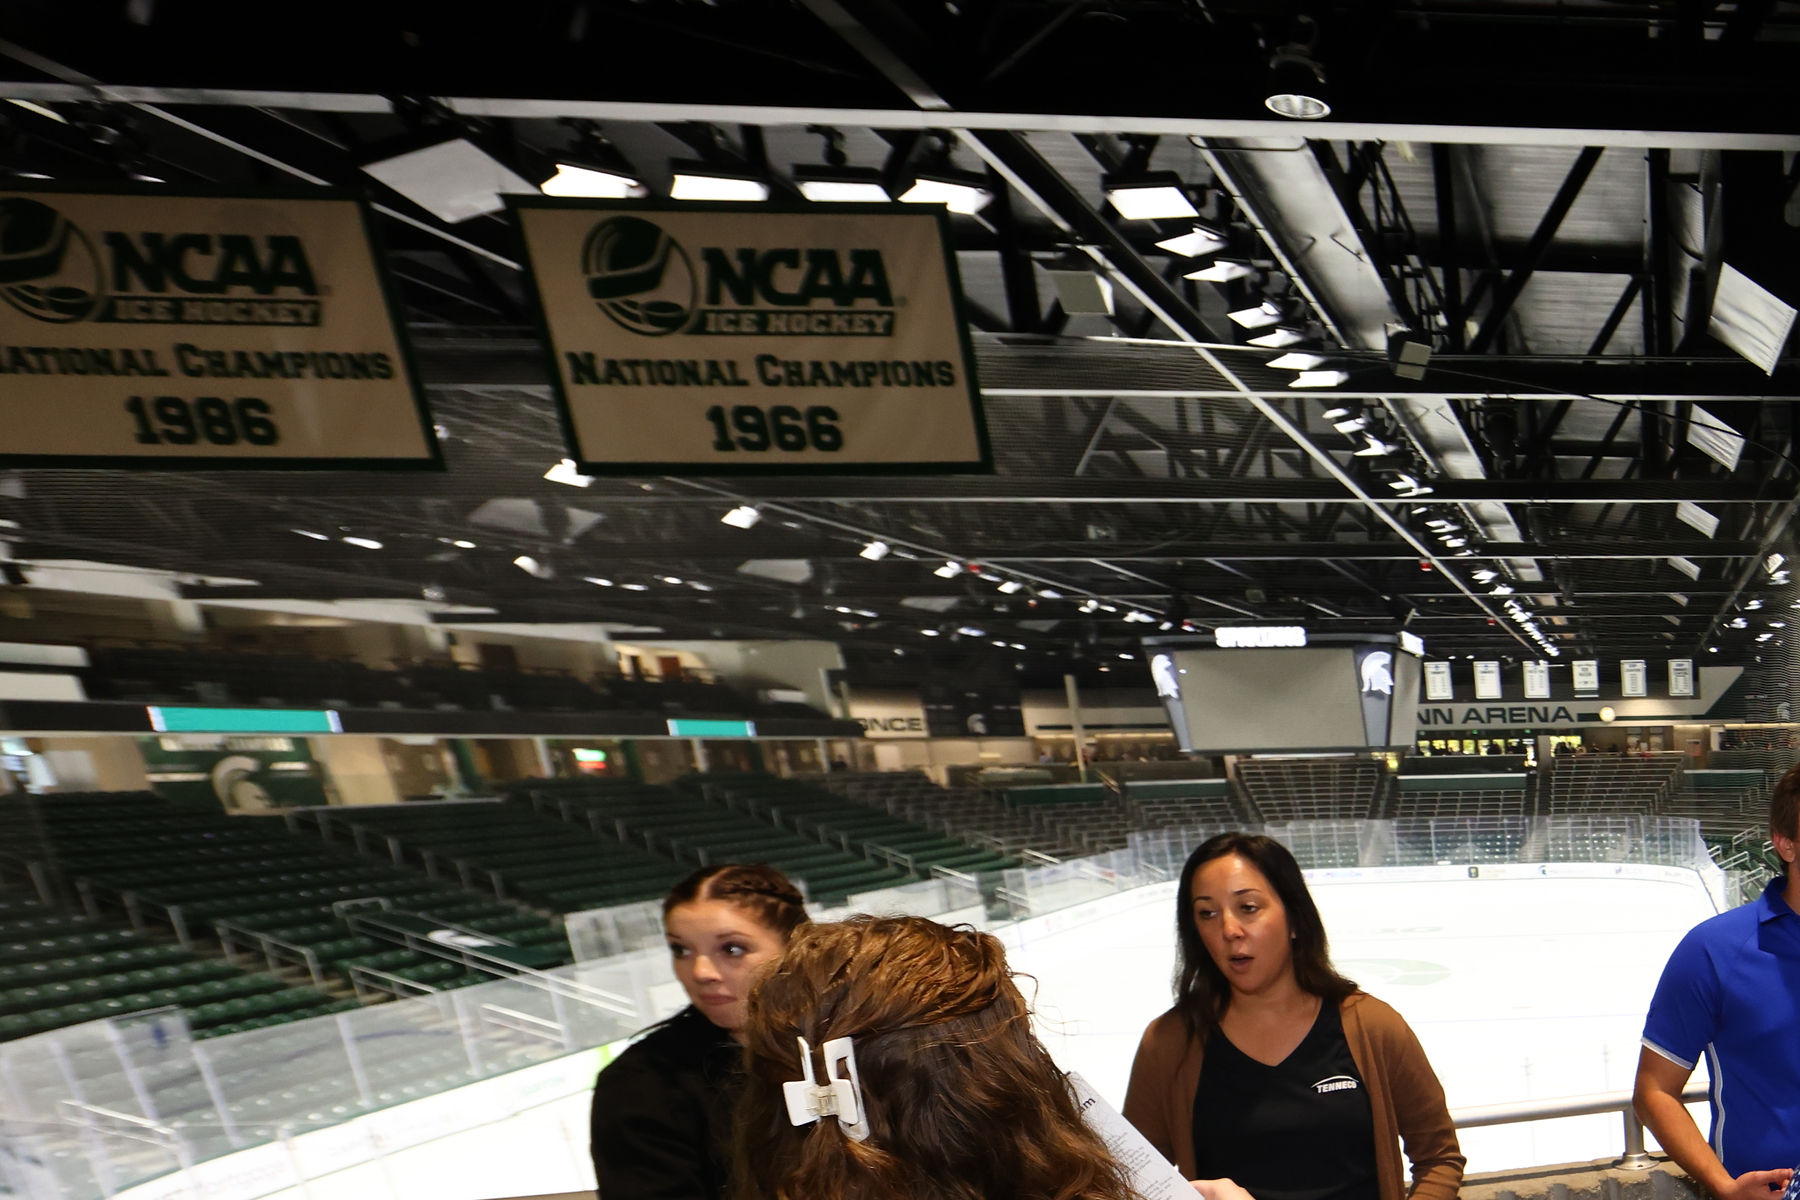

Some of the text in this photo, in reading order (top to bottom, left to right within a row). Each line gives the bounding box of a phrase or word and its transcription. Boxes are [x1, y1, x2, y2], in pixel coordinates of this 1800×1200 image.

[104, 231, 318, 295] NCAA
[702, 247, 894, 306] NCAA
[115, 300, 317, 325] ICE HOCKEY
[706, 312, 892, 334] ICE HOCKEY
[0, 346, 169, 377] ATIONAL
[565, 352, 956, 387] NATIONAL CHAMPIONS
[125, 395, 279, 446] 1986
[705, 405, 844, 452] 1966
[1462, 706, 1574, 724] ARENA
[1316, 1080, 1357, 1094] TENNECO
